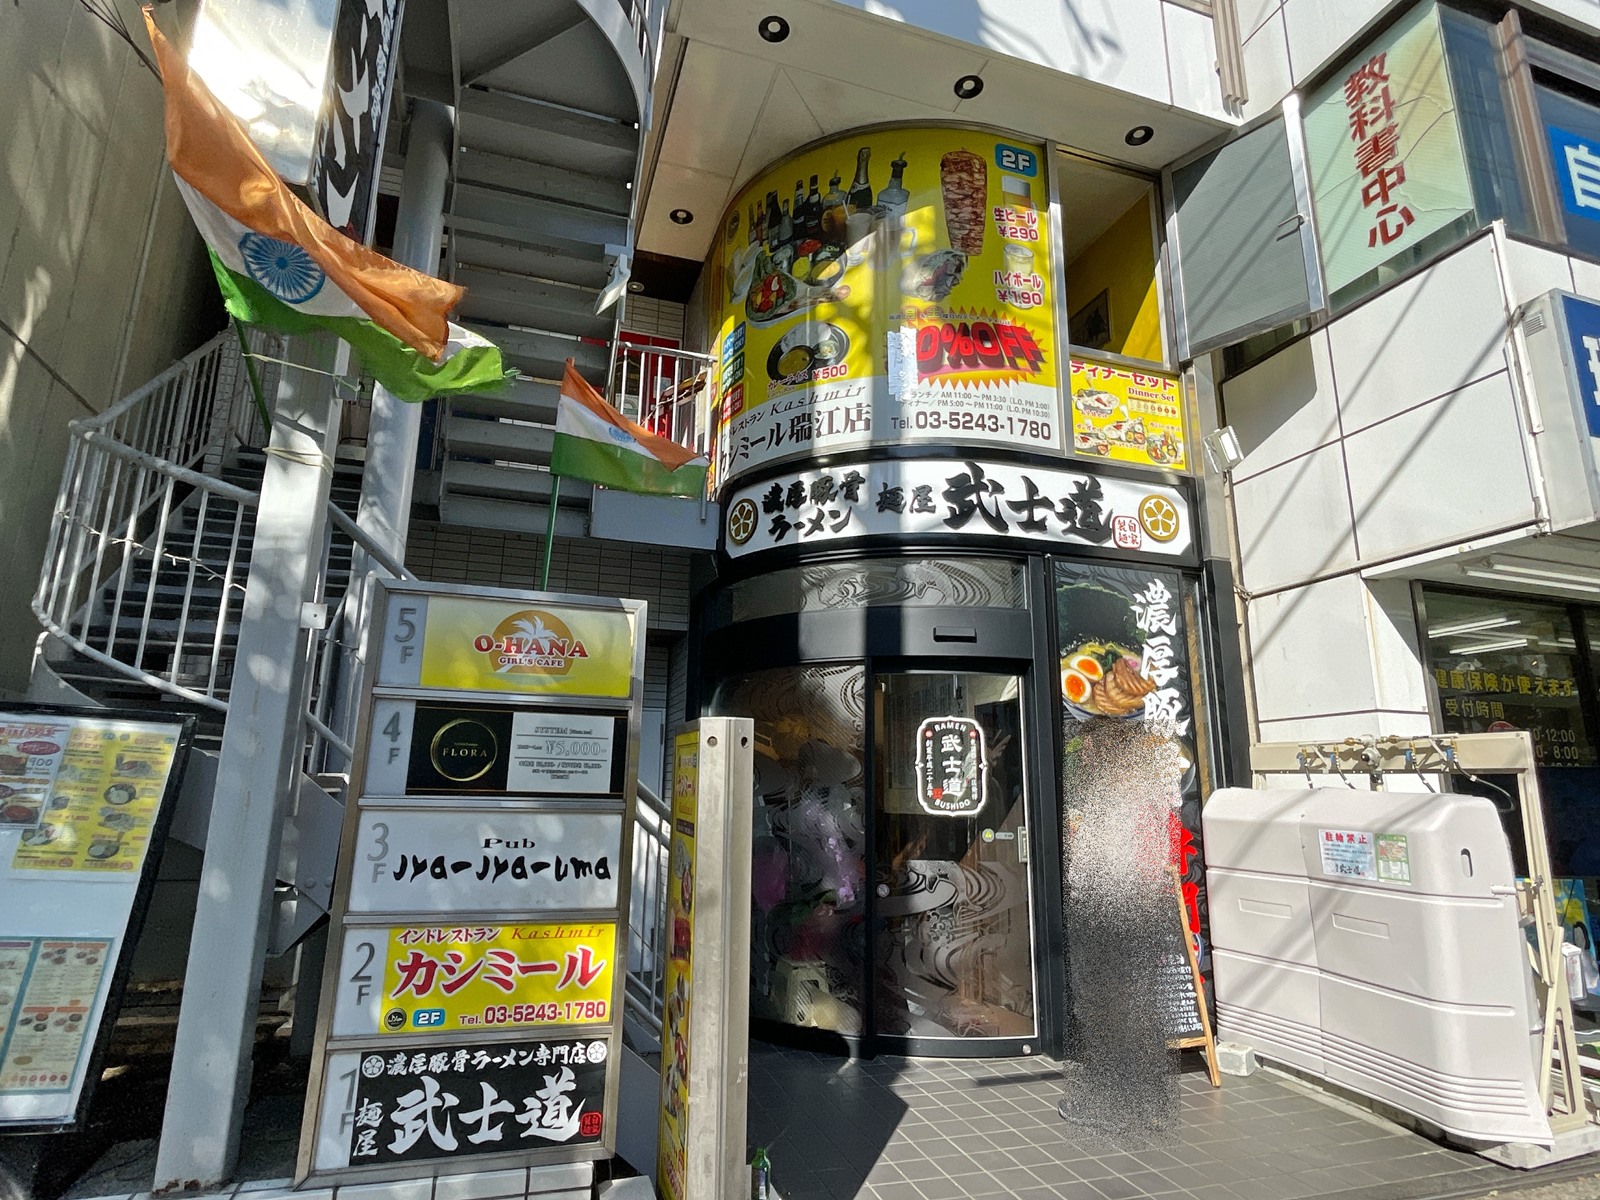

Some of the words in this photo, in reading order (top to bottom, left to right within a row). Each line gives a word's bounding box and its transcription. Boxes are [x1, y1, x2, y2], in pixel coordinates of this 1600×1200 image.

[1002, 150, 1030, 170] 2F
[1344, 52, 1415, 248] 教科書中心
[994, 208, 1037, 224] 生ビール
[998, 226, 1039, 241] ¥290
[994, 271, 1041, 288] ハイボール
[998, 290, 1043, 306] ¥190
[916, 321, 1047, 374] 0%OFF
[812, 364, 847, 381] ¥500
[1071, 361, 1175, 391] ディナーセット
[770, 385, 866, 416] Kashmir
[1128, 387, 1160, 399] Dinner
[1160, 392, 1175, 402] Set
[891, 417, 913, 430] Tel.
[916, 411, 1051, 440] 03-5243-1780
[761, 470, 866, 514] 濃厚豚骨
[941, 460, 1114, 545] 武士道
[768, 506, 852, 543] ラーメン
[474, 635, 589, 658] O-HANA
[500, 657, 534, 666] GIRL'S
[536, 658, 564, 667] CAFE
[1130, 579, 1190, 740] 濃厚豚
[1435, 669, 1574, 697] 健康保険が使えます
[1445, 699, 1504, 719] 受付時間
[935, 722, 966, 732] RAMEN
[1532, 728, 1576, 743] 0-12:00
[443, 748, 488, 757] FLORA
[941, 734, 962, 797] 武士道
[935, 799, 970, 810] BUSHIDO
[482, 838, 536, 849] Pub
[398, 927, 500, 944] インドレストラン
[511, 926, 605, 940] Kashmir
[392, 946, 606, 999] カシミール
[418, 1011, 440, 1024] 2F
[460, 1014, 482, 1025] Tel.
[485, 1001, 606, 1024] 03-5243-1780
[387, 1043, 587, 1076] 濃厚豚骨ラーメン専門店
[387, 1065, 587, 1155] 武士道
